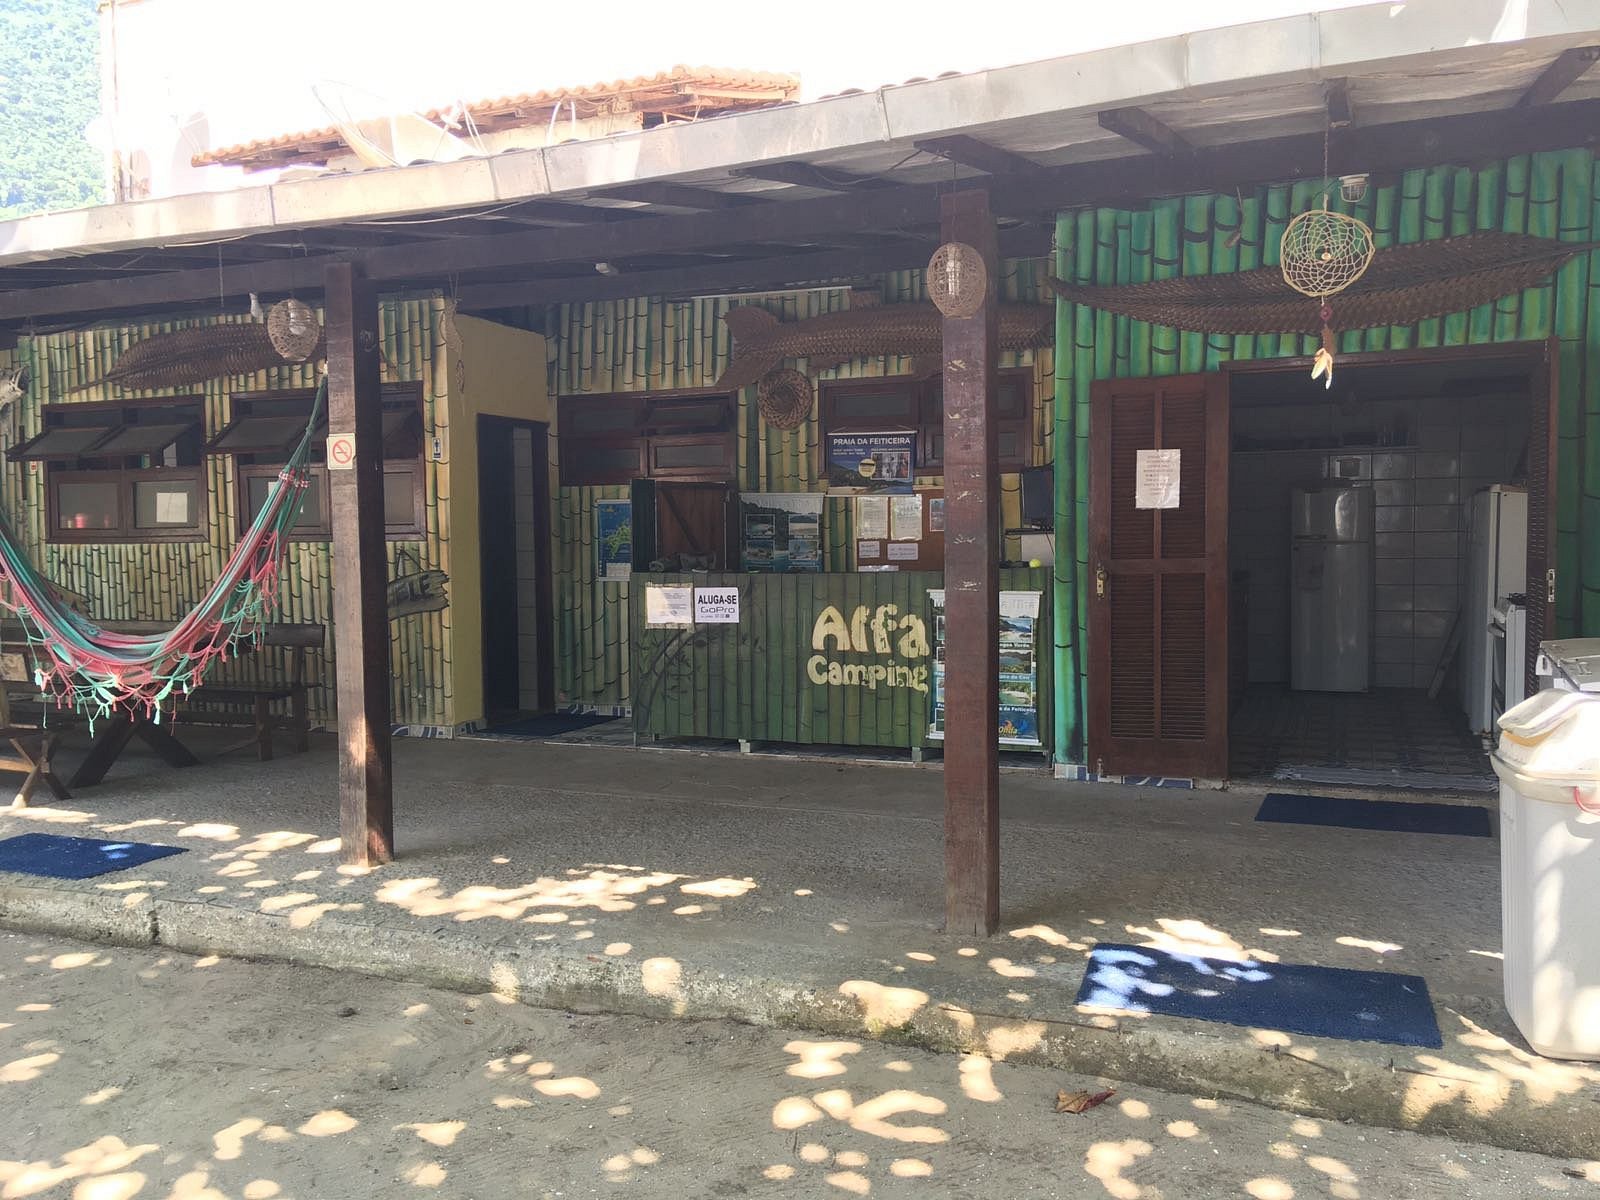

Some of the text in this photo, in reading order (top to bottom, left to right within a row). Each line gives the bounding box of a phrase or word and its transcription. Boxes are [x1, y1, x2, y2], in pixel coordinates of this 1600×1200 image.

[833, 438, 856, 446] PRAIA
[869, 437, 911, 445] FEITICEIRA
[697, 594, 737, 605] ALUGA-SE
[700, 606, 736, 614] GoPro
[812, 603, 930, 659] Alfa
[807, 654, 929, 698] Camping
